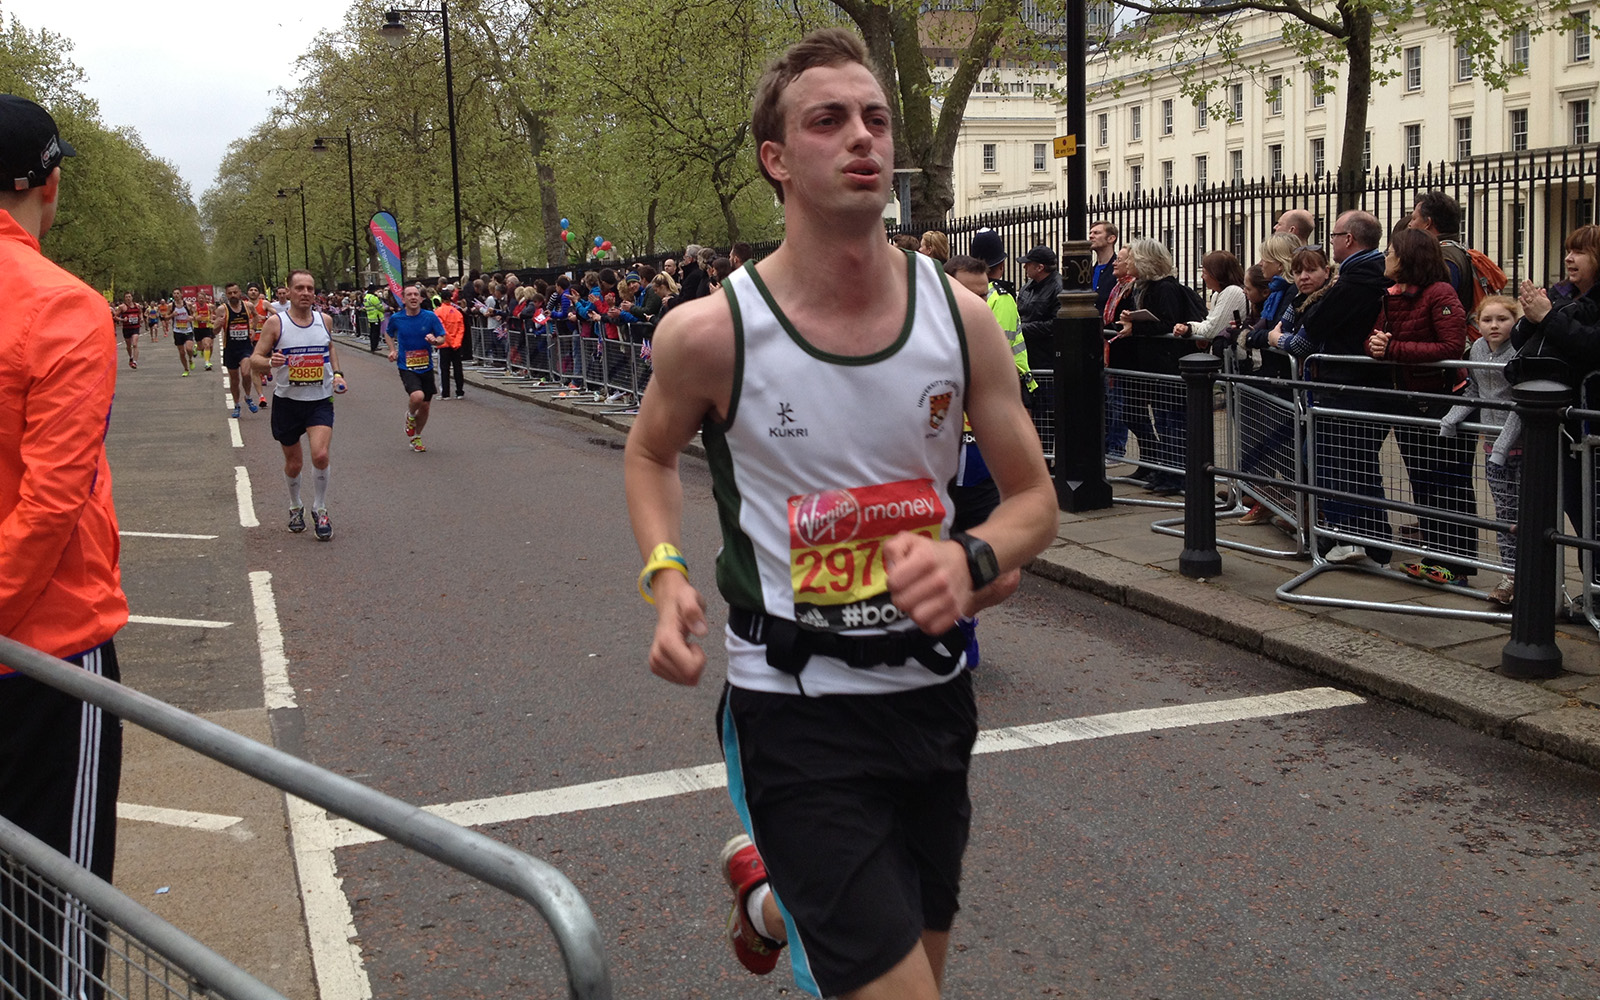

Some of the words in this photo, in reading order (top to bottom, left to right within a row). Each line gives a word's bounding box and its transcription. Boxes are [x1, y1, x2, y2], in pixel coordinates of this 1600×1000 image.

[290, 367, 323, 379] 29850
[917, 380, 943, 408] UNIVERSITY
[769, 427, 808, 437] KUKRI
[801, 494, 855, 541] Virgin
[864, 498, 935, 522] money
[842, 601, 905, 628] #bo
